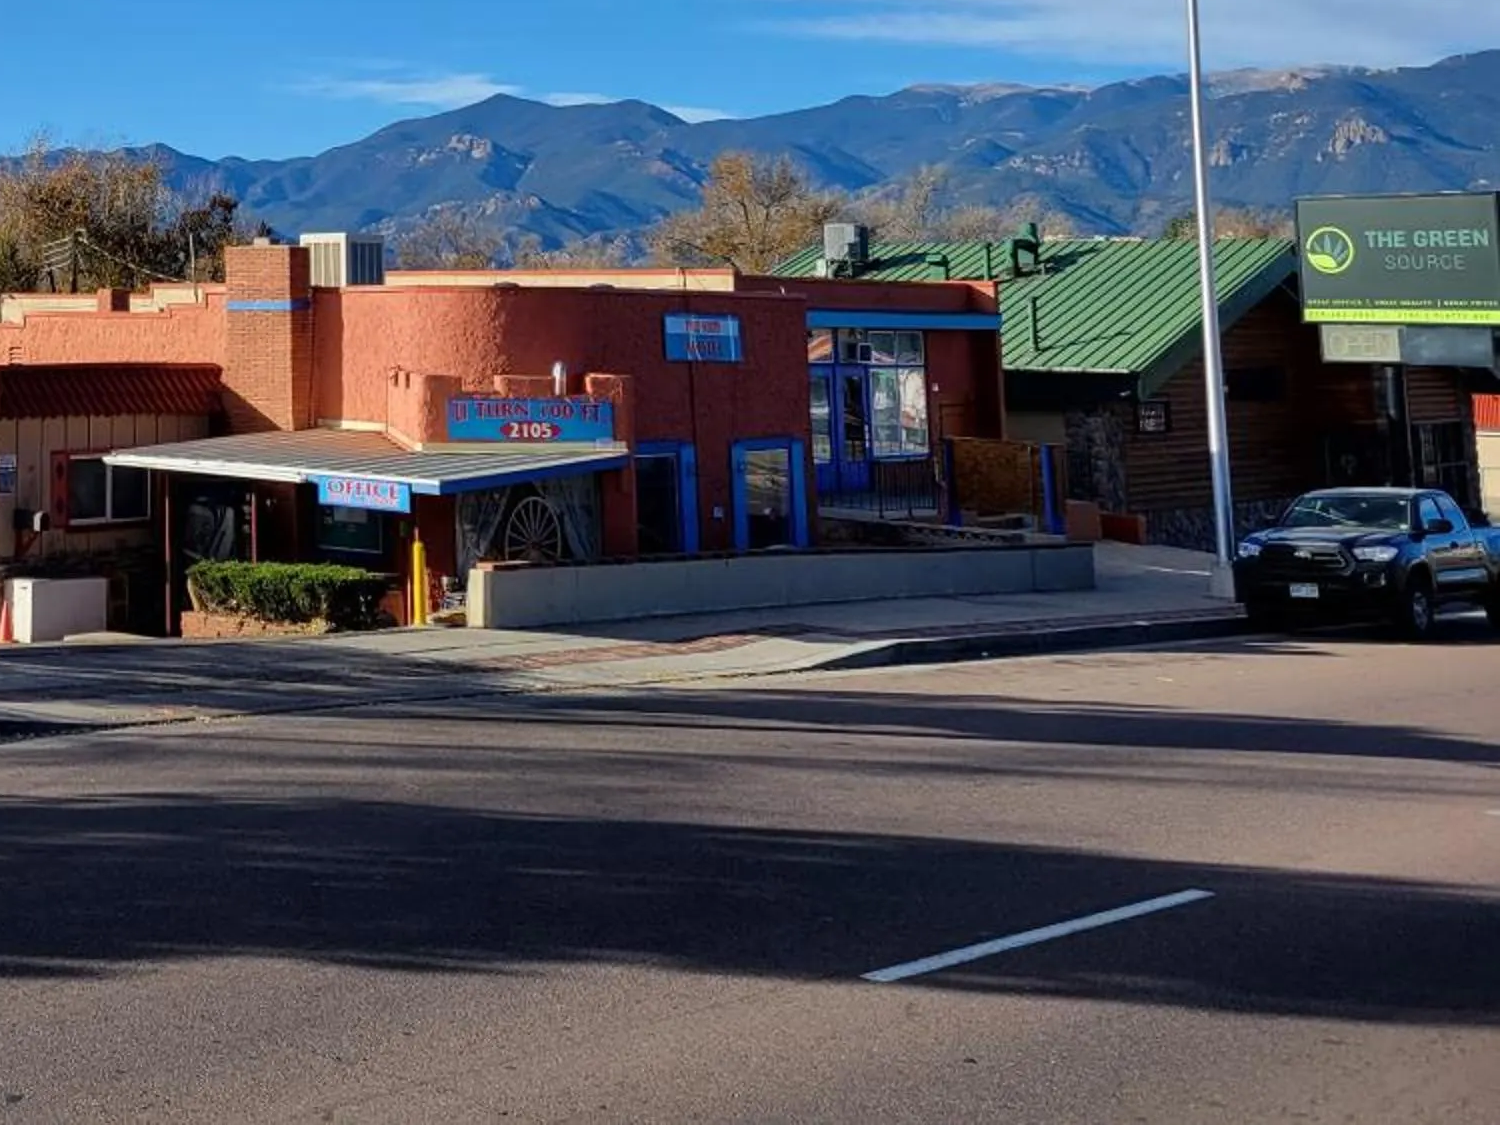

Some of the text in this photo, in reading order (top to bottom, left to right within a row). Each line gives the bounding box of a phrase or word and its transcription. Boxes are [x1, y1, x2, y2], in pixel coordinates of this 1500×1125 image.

[1364, 229, 1489, 248] THE GREEN
[1384, 253, 1467, 271] SOURCE
[508, 421, 552, 439] 2105
